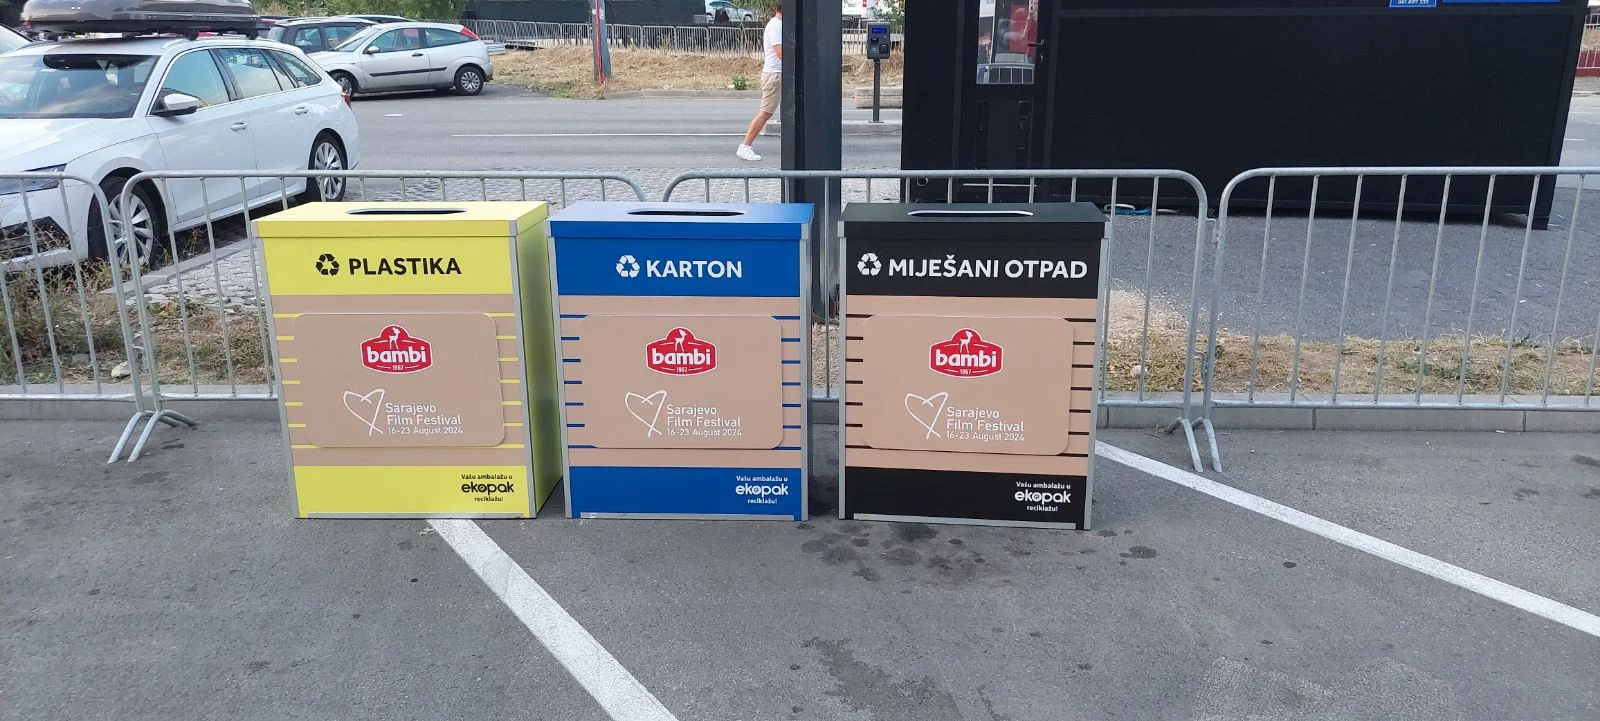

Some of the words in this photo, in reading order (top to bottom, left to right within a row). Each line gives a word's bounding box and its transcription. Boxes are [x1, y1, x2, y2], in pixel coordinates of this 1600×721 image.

[348, 257, 462, 276] PLASTIKA
[646, 260, 743, 279] KARTON
[888, 255, 999, 278] MIJEŠANI
[1004, 259, 1088, 279] OTPAD
[366, 346, 427, 363] bambi
[651, 348, 711, 365] bambi
[935, 349, 997, 368] bambi
[385, 402, 436, 415] Sarajevo
[666, 404, 717, 417] Sarajevo
[946, 406, 1000, 420] Sarajevo
[387, 414, 413, 425] Film
[416, 414, 462, 425] Festival
[667, 416, 693, 427] Film
[696, 416, 741, 427] Festival
[946, 418, 973, 430] Film
[977, 420, 1024, 432] Festival
[387, 426, 411, 435] 16-23
[413, 427, 442, 436] August
[666, 428, 690, 436] 16-23
[692, 428, 721, 438] August
[722, 428, 742, 436] 2024
[946, 431, 970, 440] 16-23
[972, 432, 1002, 442] August
[1004, 433, 1025, 441] 2024
[461, 481, 514, 495] ekopak
[735, 483, 789, 498] ekopak
[1014, 489, 1071, 505] ekopak
